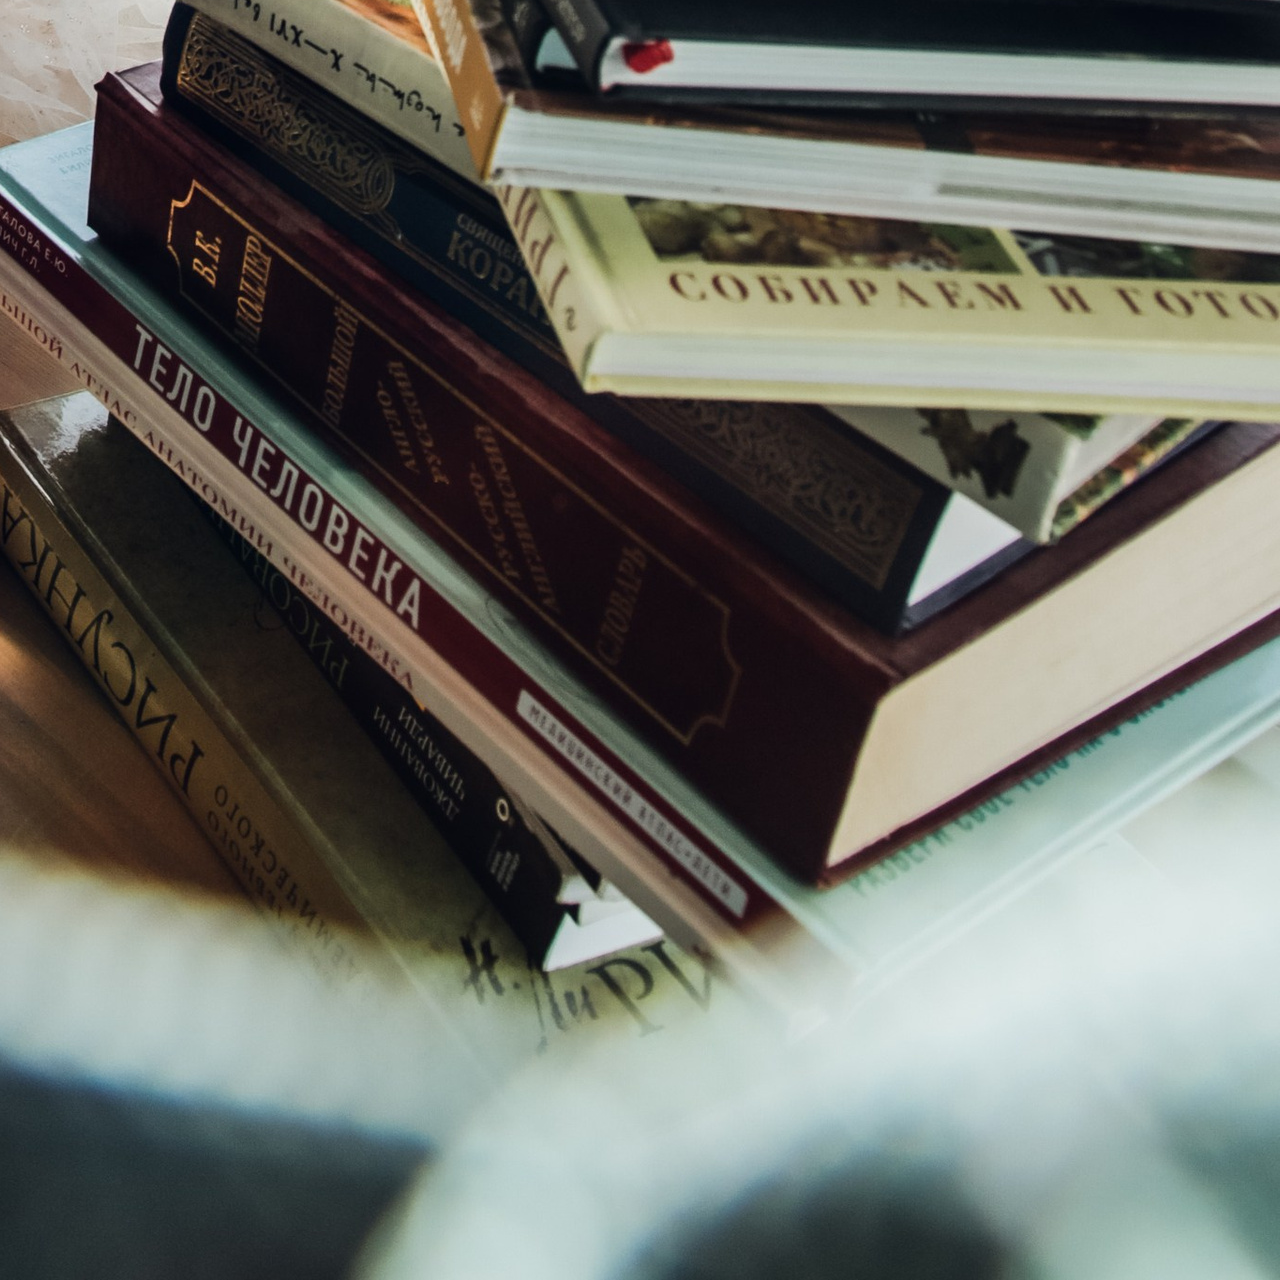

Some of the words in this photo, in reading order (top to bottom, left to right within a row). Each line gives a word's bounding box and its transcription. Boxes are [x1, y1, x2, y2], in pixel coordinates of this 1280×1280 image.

[21, 247, 40, 273] Г.Л.
[44, 248, 69, 278] Е.Ю.
[192, 230, 223, 288] В.К.
[667, 270, 1024, 315] СОБИРАЕМ
[1056, 285, 1098, 315] И
[322, 305, 359, 427] БОЛЬШОЙ
[71, 362, 138, 429] АТЛАС
[145, 431, 274, 557] АНАТОМИИ
[283, 557, 414, 690] ЧЕЛОВЕКА
[133, 323, 216, 432] ТЕЛО
[233, 415, 421, 630] ЧЕЛОВЕКА
[2, 484, 205, 800] РИСУНКА
[597, 545, 647, 667] СЛОВАРЬ
[373, 706, 459, 821] ДЖОВАННИ
[398, 706, 465, 801] ЧИВАРДИ
